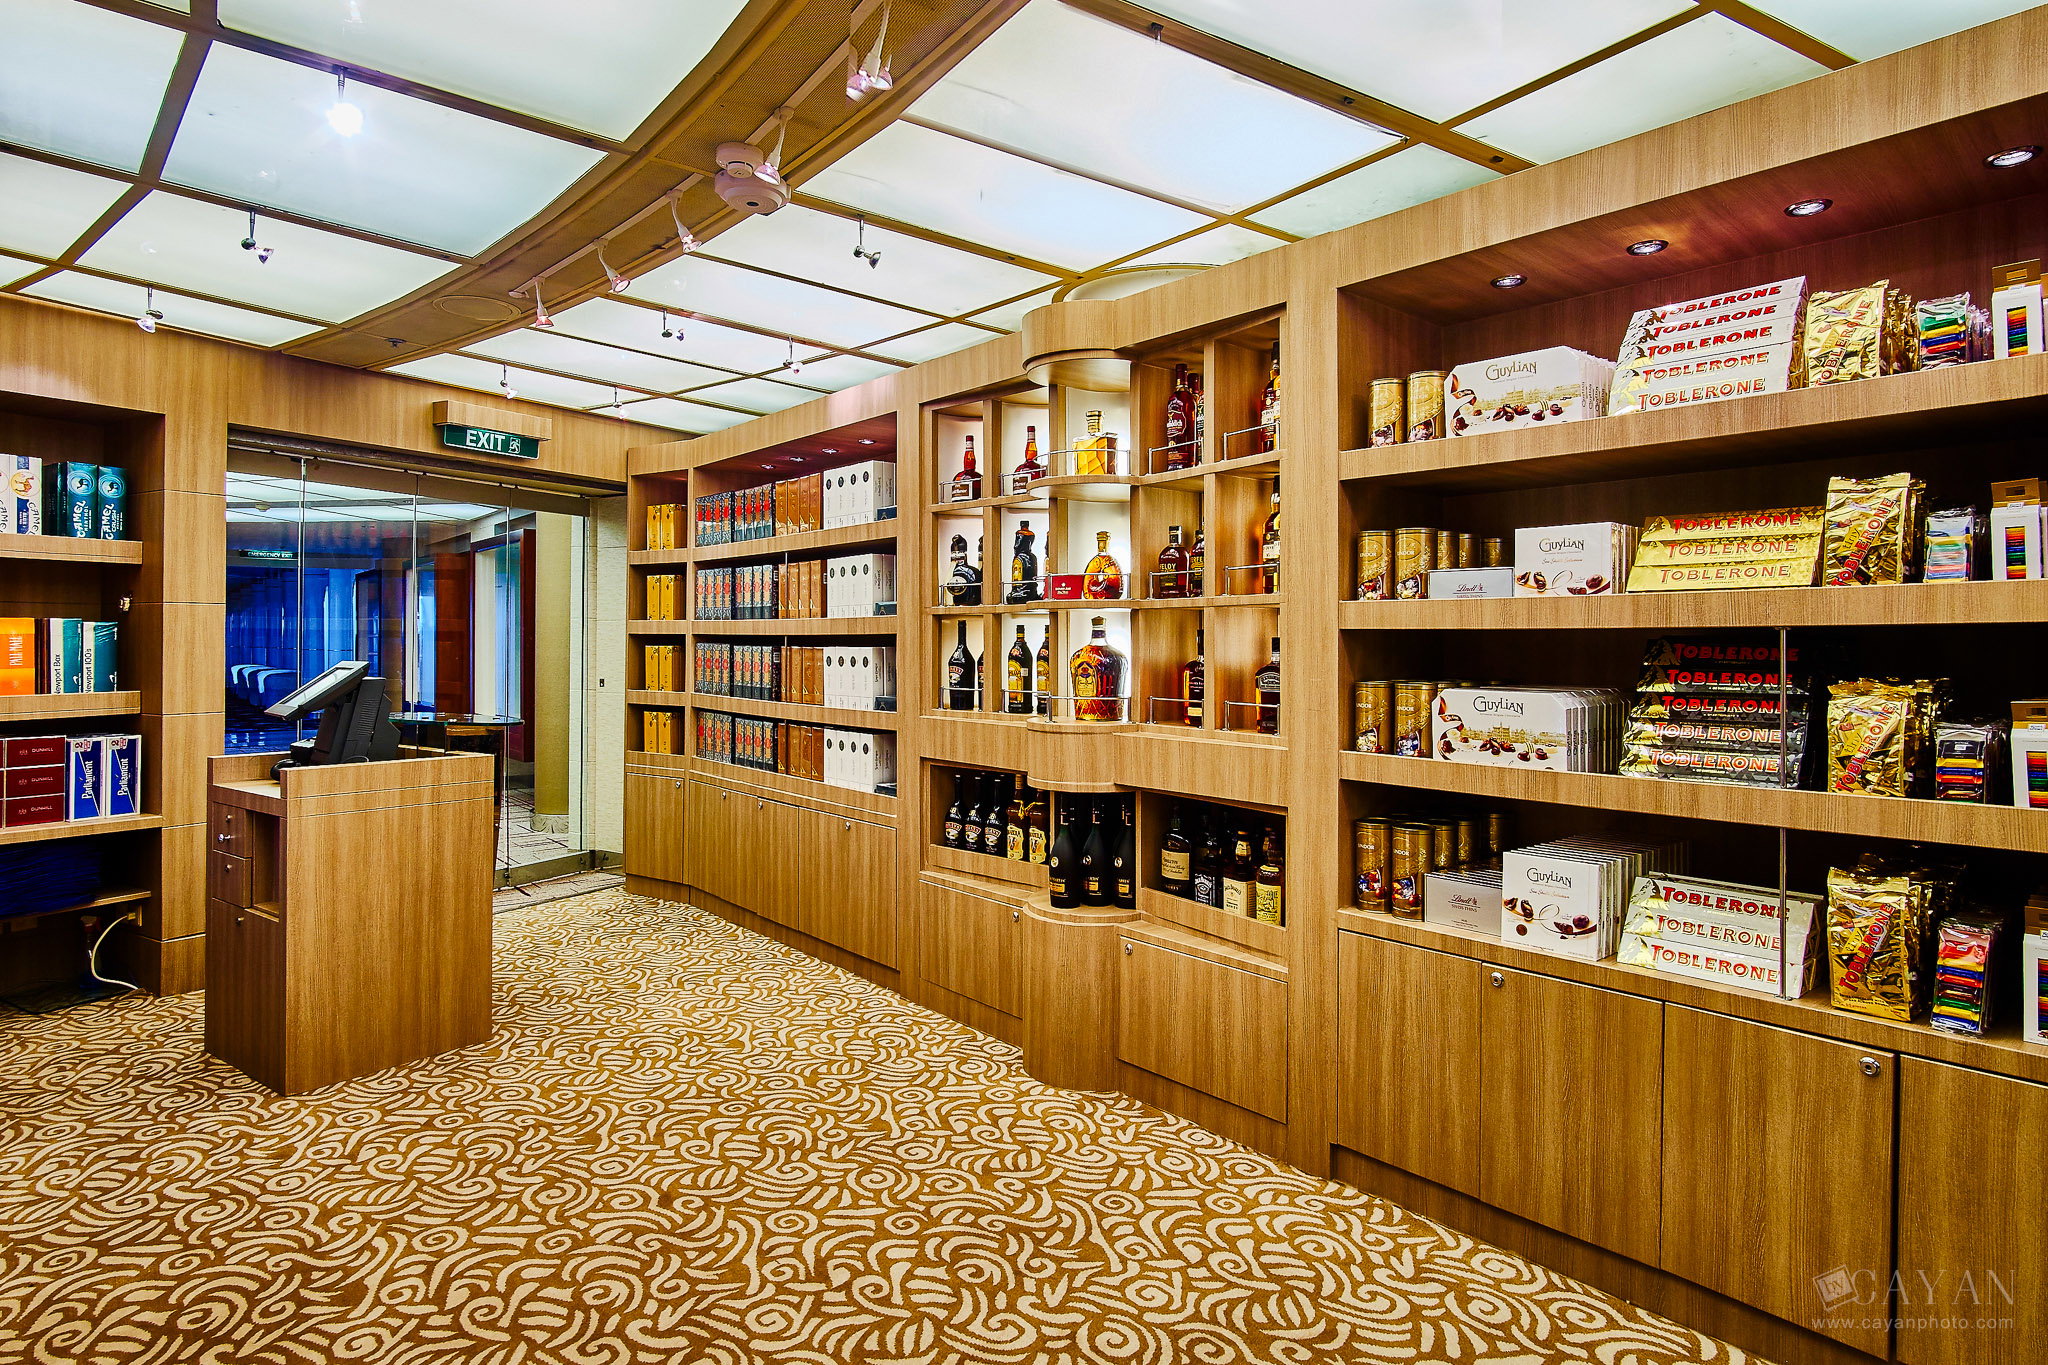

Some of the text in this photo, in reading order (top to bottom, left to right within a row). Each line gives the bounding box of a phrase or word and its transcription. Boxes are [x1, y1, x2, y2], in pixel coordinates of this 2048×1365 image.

[1660, 286, 1782, 319] TOBLERONE
[1654, 304, 1777, 338] TOBLERONE
[1648, 326, 1774, 360] TOBLERONE
[1642, 352, 1770, 384] TOBLERONE
[1638, 377, 1766, 410] TOBLERONE
[466, 430, 505, 451] EXIT
[72, 500, 86, 538] CAMEL
[102, 503, 114, 540] CAMEL
[1674, 514, 1802, 534] TOBLERONE
[1668, 540, 1798, 558] TOBLERONE
[1831, 498, 1898, 586] TOBLERONE
[1456, 583, 1478, 592] Lindt
[1661, 565, 1792, 584] TOBLERONE
[8, 636, 23, 666] PALL MALL
[1674, 644, 1800, 662] TOBLERONE
[1654, 722, 1782, 744] TOBLERONE
[1835, 704, 1896, 793] TOBLERONE
[117, 758, 128, 796] Parliament
[1651, 749, 1780, 772] TOBLERONE
[82, 760, 93, 799] Parliament
[1452, 894, 1472, 904] Lindt
[1662, 886, 1790, 920] TOBLERONE
[1657, 914, 1780, 950] TOBLERONE
[1839, 904, 1895, 992] TOBLERONE
[1651, 944, 1780, 984] TOBLERONE
